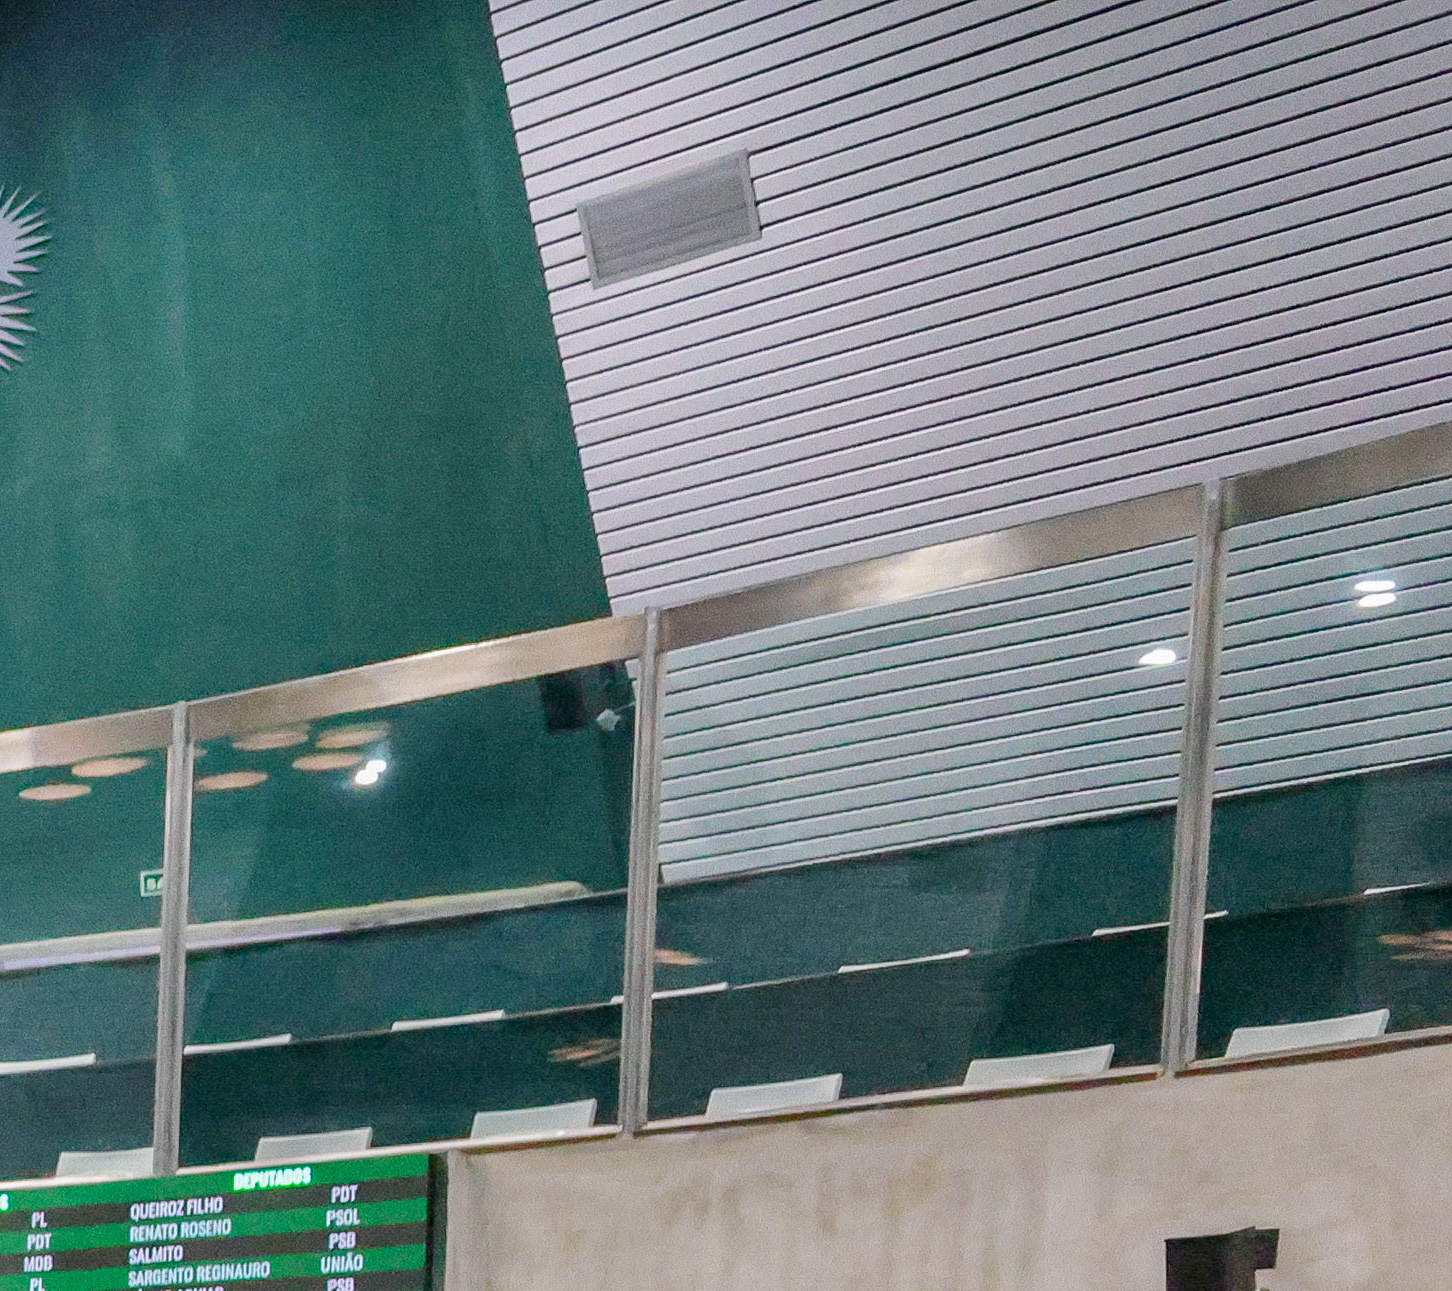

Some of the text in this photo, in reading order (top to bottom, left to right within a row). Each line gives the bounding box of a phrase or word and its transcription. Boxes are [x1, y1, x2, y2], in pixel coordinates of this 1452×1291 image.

[234, 1168, 310, 1189] DEPUTADOS
[332, 1185, 357, 1202] PDT
[131, 1197, 223, 1219] QUEIROZ FILHO
[32, 1212, 47, 1227] PL
[327, 1209, 360, 1225] PSOL
[131, 1219, 231, 1241] RENATO ROSENO
[28, 1234, 51, 1249] PDT
[329, 1232, 355, 1248] PSB
[130, 1245, 183, 1263] SALMITO
[322, 1253, 363, 1272] UNIÃO
[24, 1255, 52, 1271] MDB
[129, 1262, 270, 1287] SARGENTO REGINAURO
